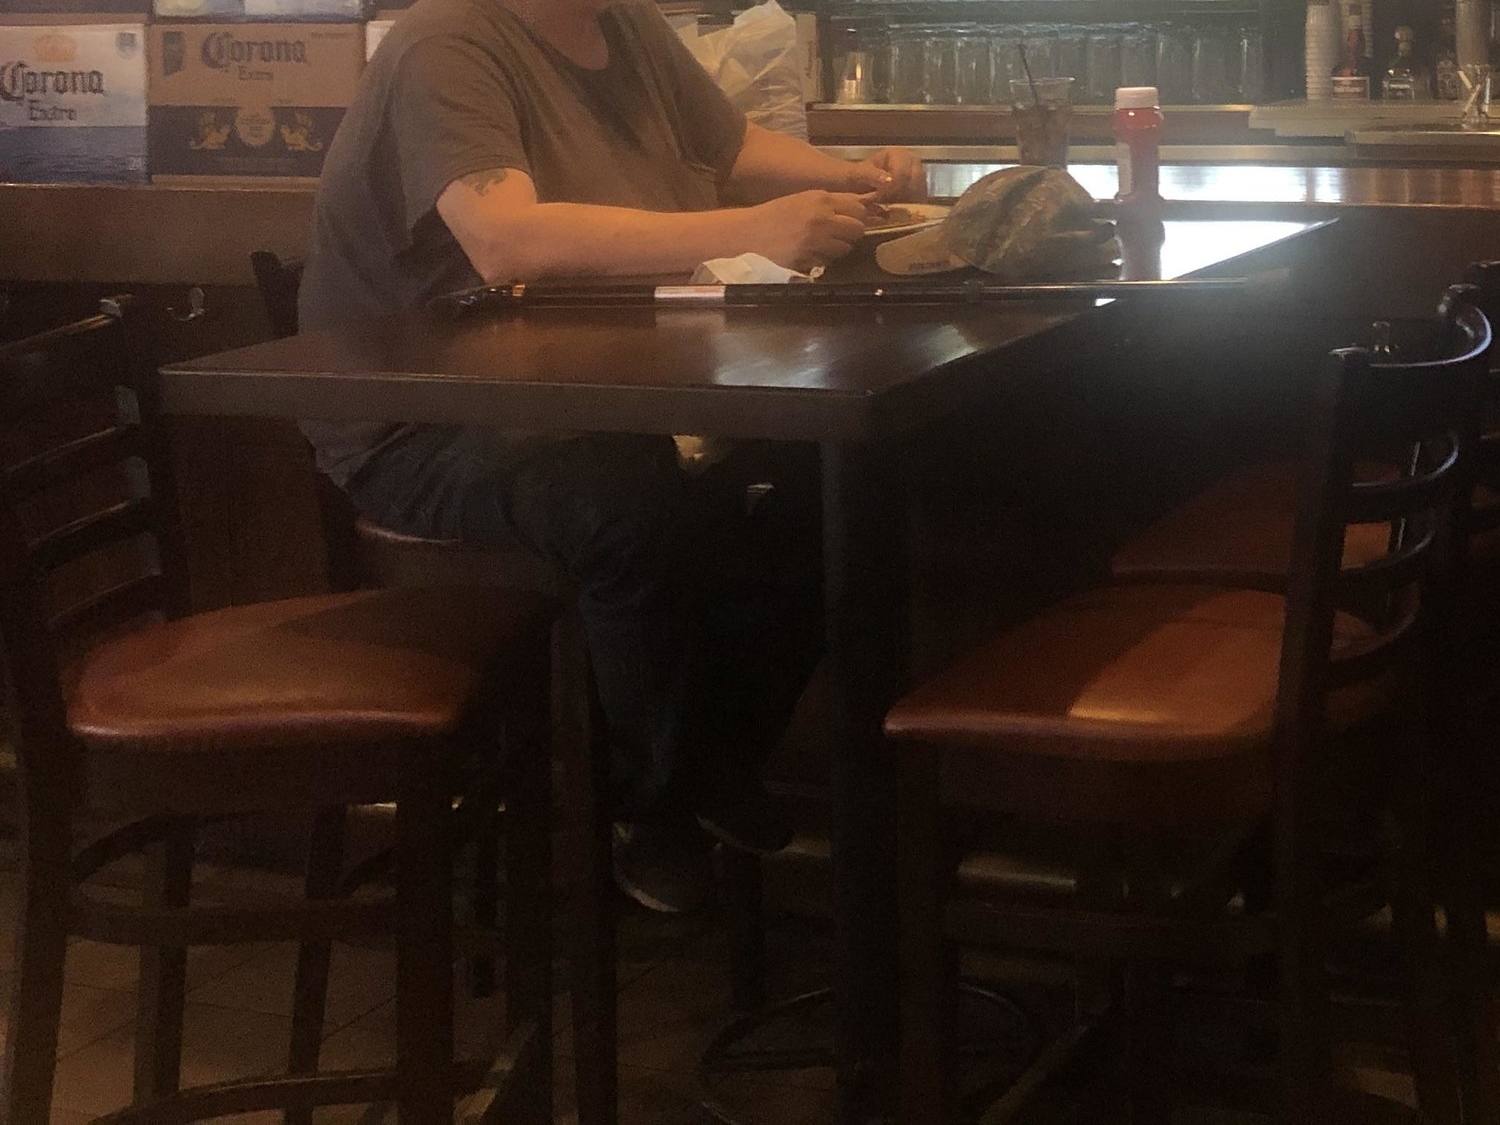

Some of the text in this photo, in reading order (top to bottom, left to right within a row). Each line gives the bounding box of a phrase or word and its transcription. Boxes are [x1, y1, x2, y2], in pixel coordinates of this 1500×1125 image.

[201, 31, 307, 73] Corona
[0, 61, 104, 107] Corona
[27, 99, 77, 121] Extra
